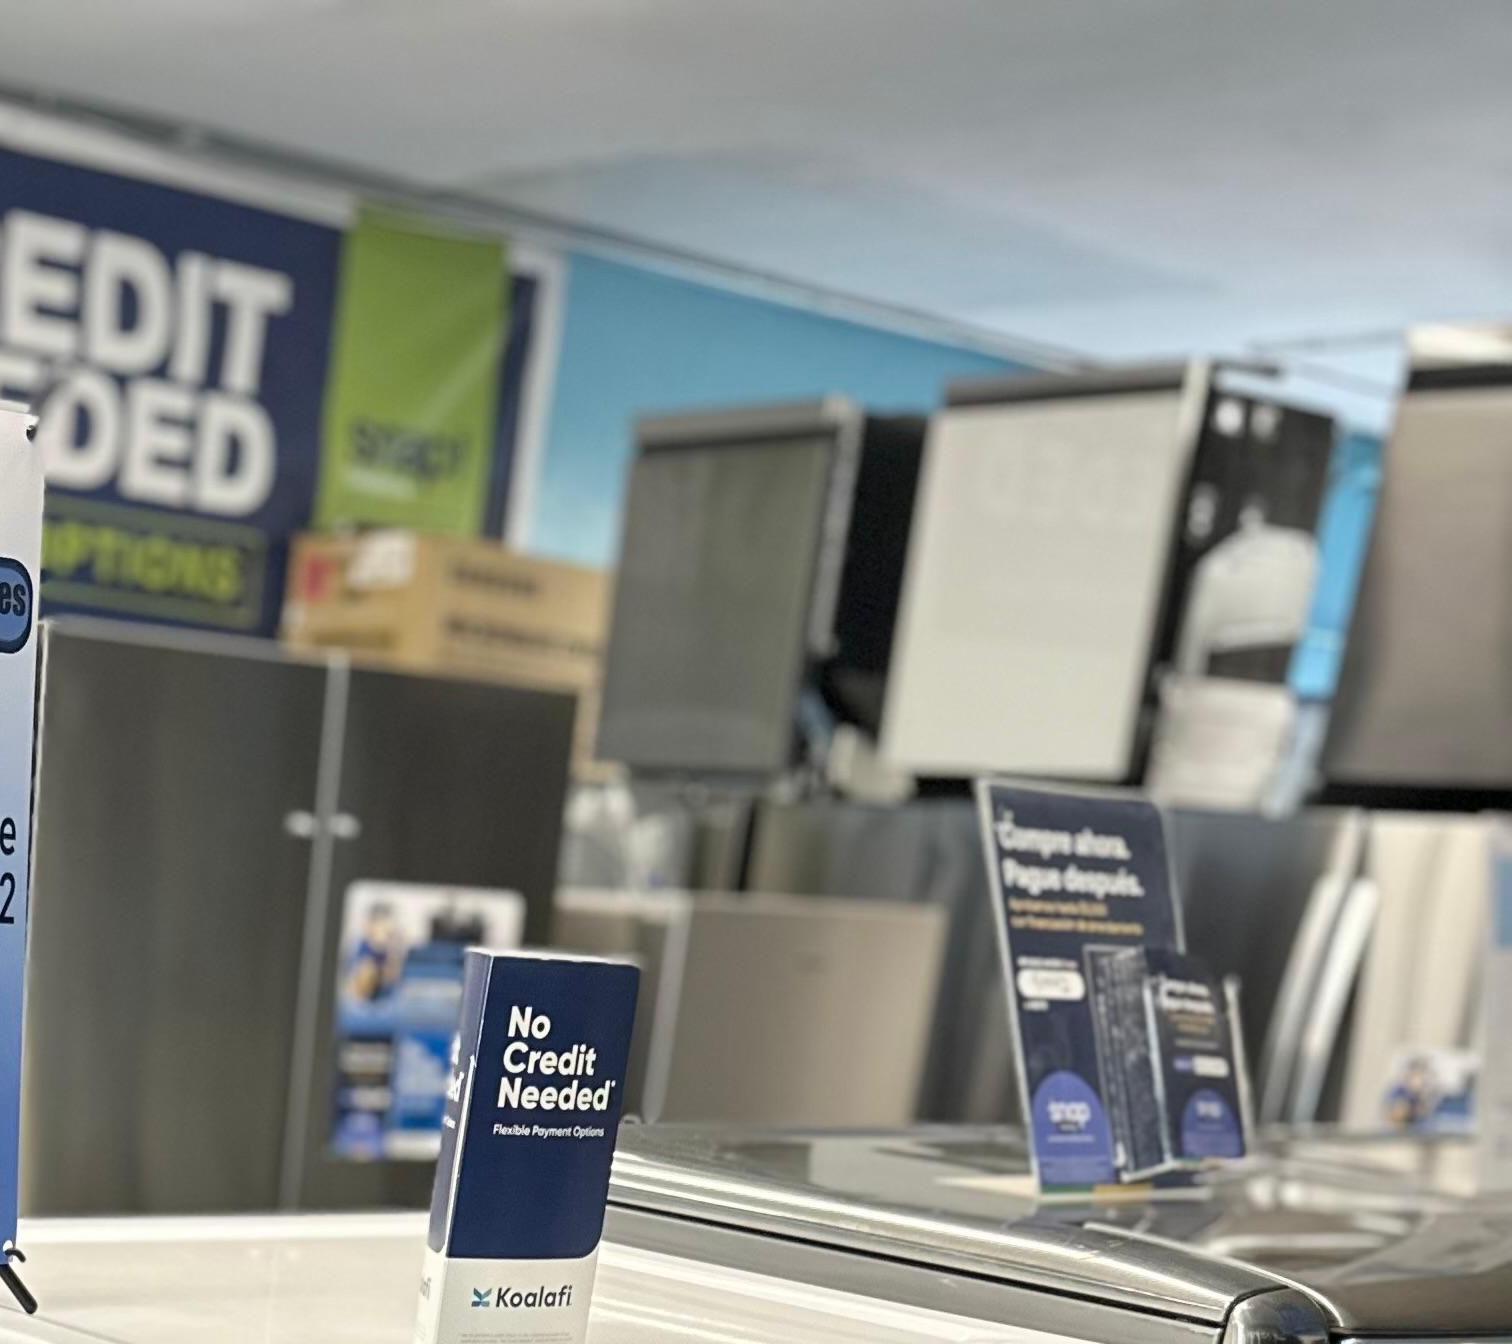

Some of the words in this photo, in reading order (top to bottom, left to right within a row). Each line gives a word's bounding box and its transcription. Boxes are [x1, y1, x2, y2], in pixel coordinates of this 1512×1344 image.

[508, 1005, 551, 1040] No
[502, 1042, 597, 1077] Credit
[492, 1123, 531, 1136] Flexible
[532, 1124, 572, 1139] Payment
[572, 1125, 605, 1139] Options
[495, 1284, 573, 1308] Koalafi
